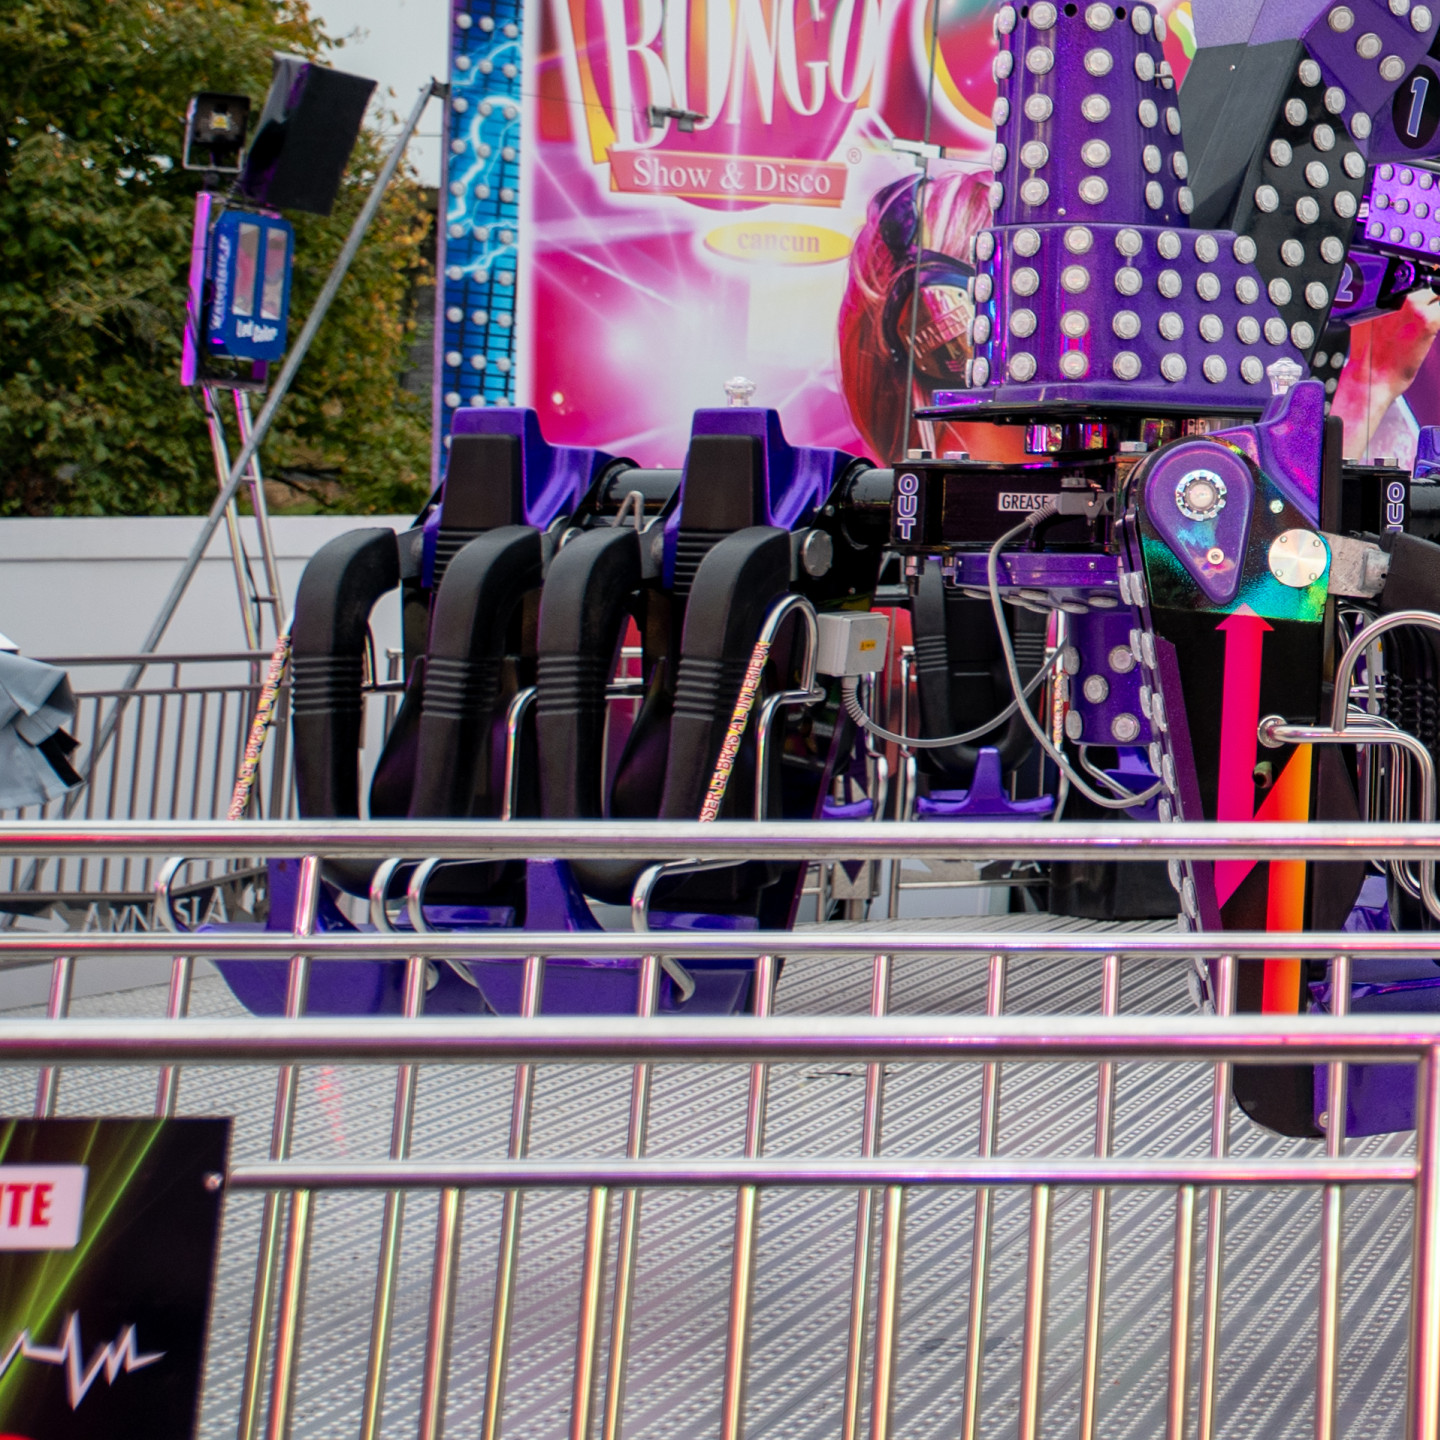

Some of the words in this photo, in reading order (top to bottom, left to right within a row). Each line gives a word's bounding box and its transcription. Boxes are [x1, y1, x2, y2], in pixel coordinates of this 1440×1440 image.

[1407, 76, 1429, 138] 1
[632, 159, 713, 190] Show
[719, 162, 745, 191] &
[755, 164, 830, 194] Disco
[737, 231, 820, 254] cancun
[1335, 263, 1353, 302] 2
[897, 473, 919, 540] OUT
[1002, 495, 1048, 510] GREASE
[715, 732, 740, 772] BRAS
[708, 770, 727, 791] LE
